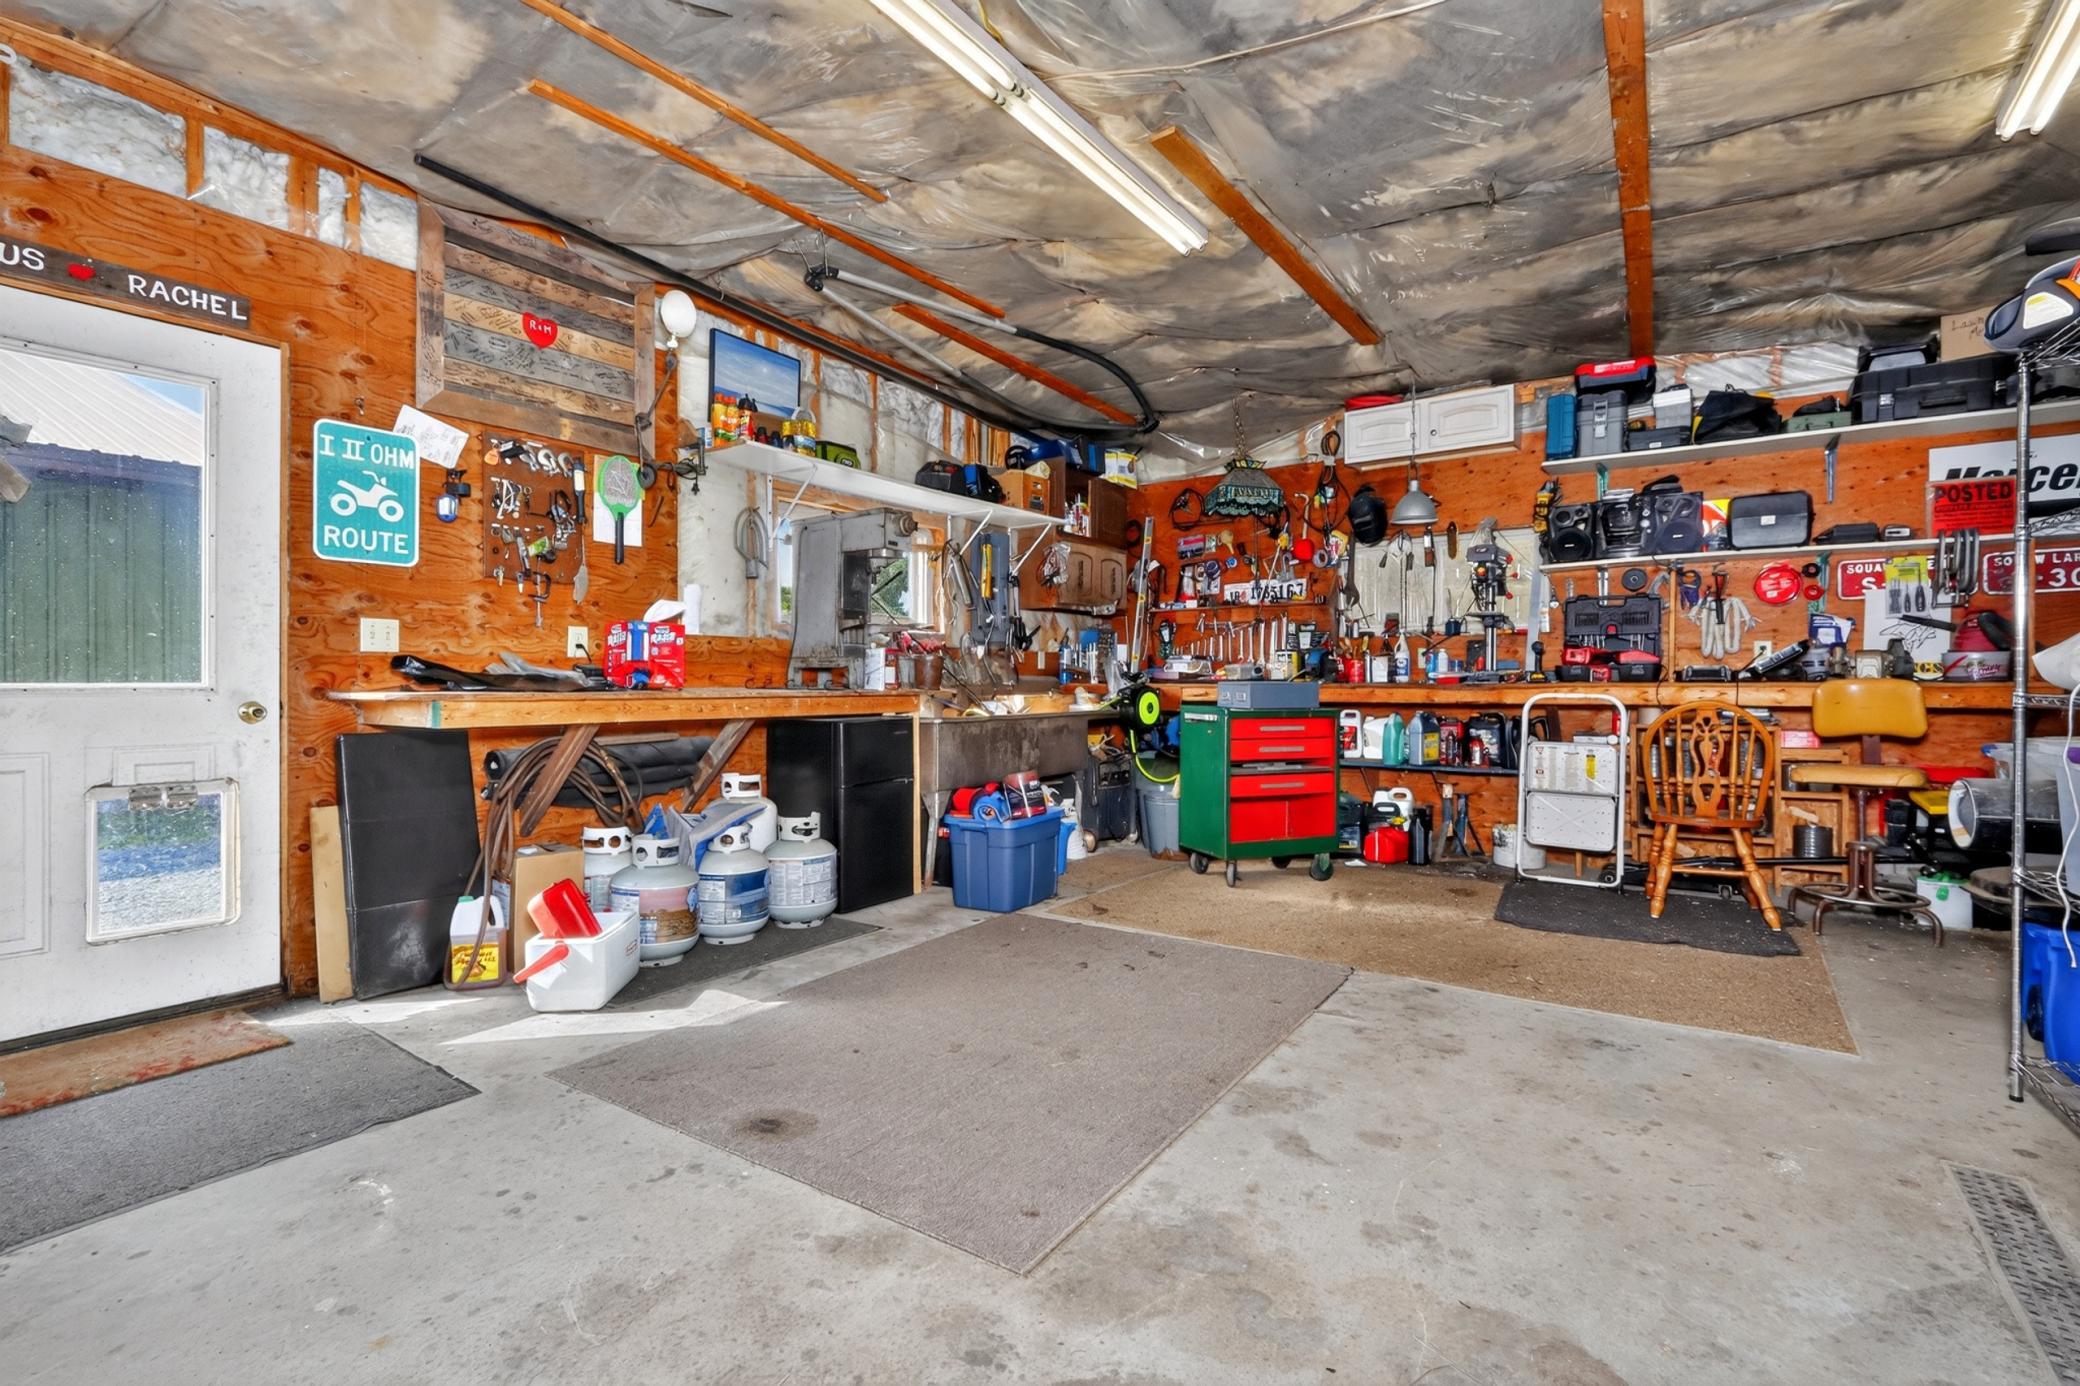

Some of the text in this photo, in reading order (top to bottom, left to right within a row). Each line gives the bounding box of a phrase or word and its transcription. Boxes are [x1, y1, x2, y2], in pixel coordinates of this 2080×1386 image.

[127, 274, 248, 321] RACHEL
[1934, 481, 2012, 503] POSTED
[323, 524, 409, 555] ROUTE
